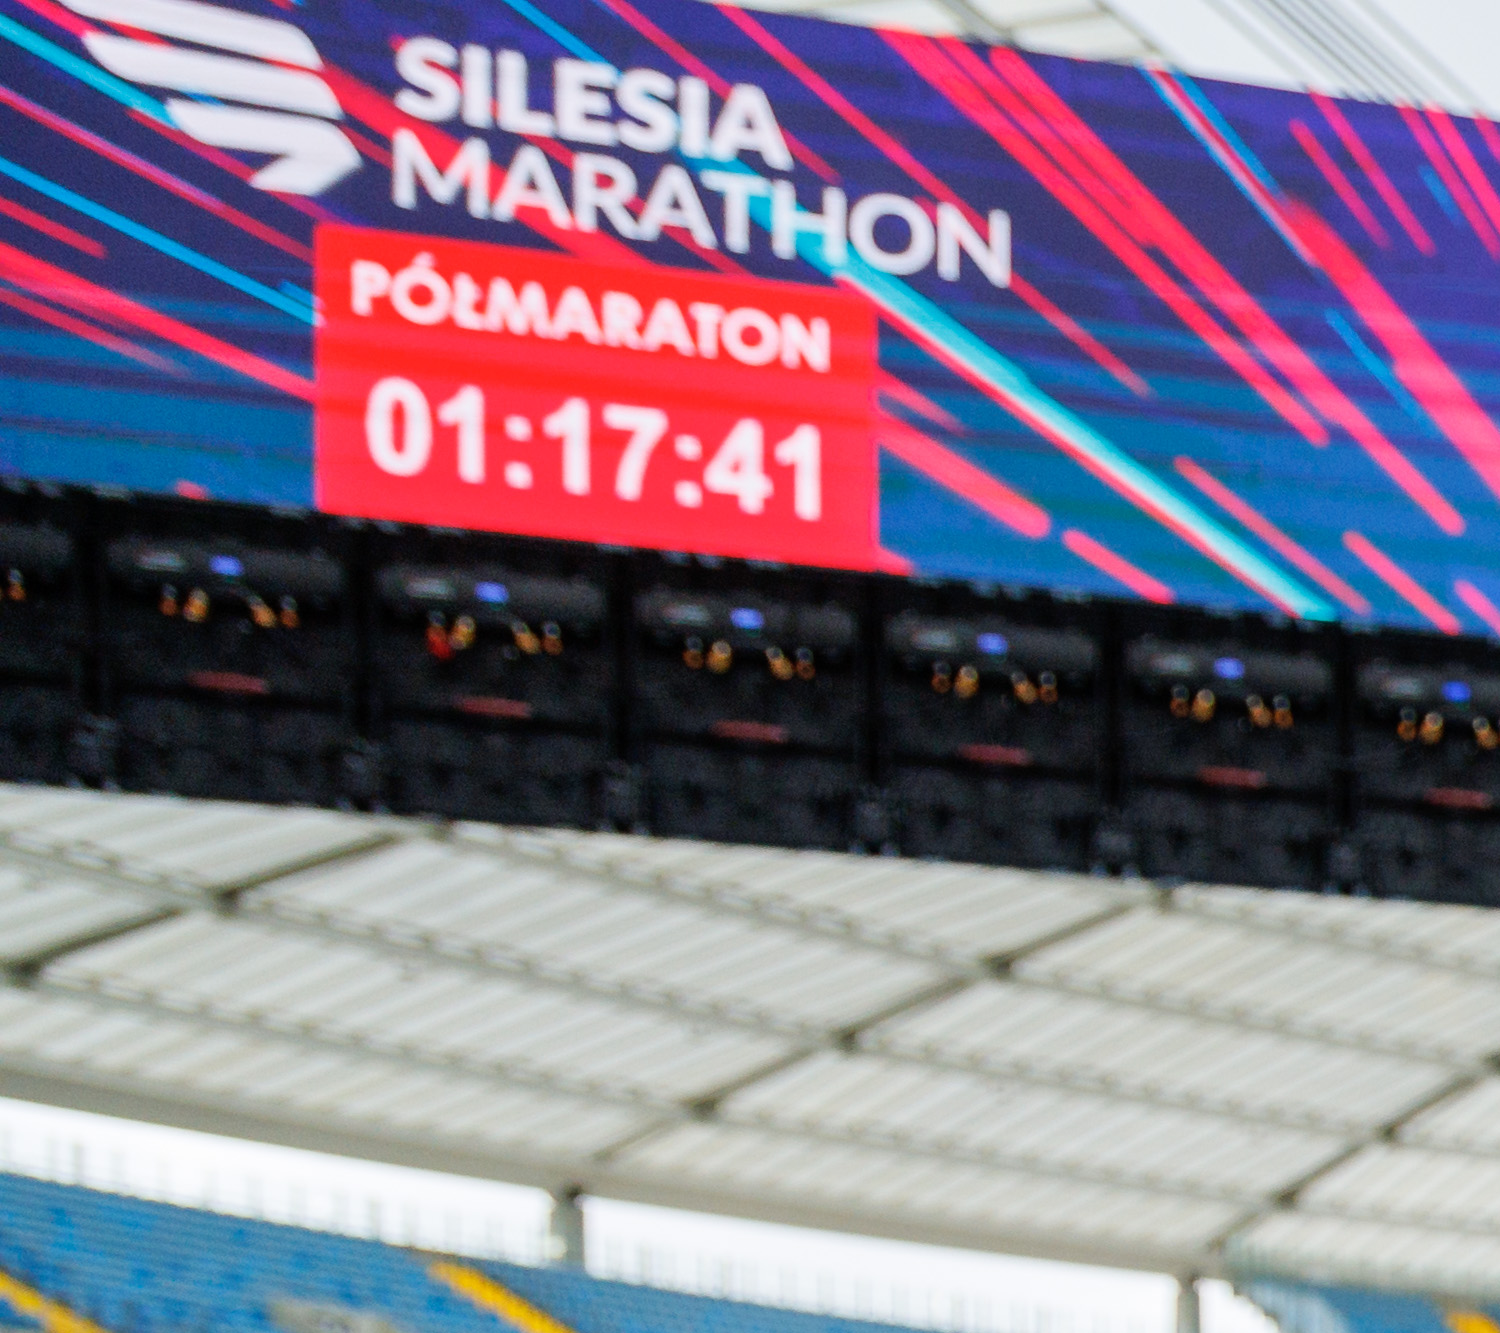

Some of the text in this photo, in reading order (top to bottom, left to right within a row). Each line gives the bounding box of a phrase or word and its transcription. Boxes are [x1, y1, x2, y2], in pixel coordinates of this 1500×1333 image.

[394, 36, 795, 170] SILESIA
[392, 127, 1012, 288] MARATHON
[351, 253, 832, 373] PÓŁMARATON
[364, 377, 823, 521] 01:17:41
